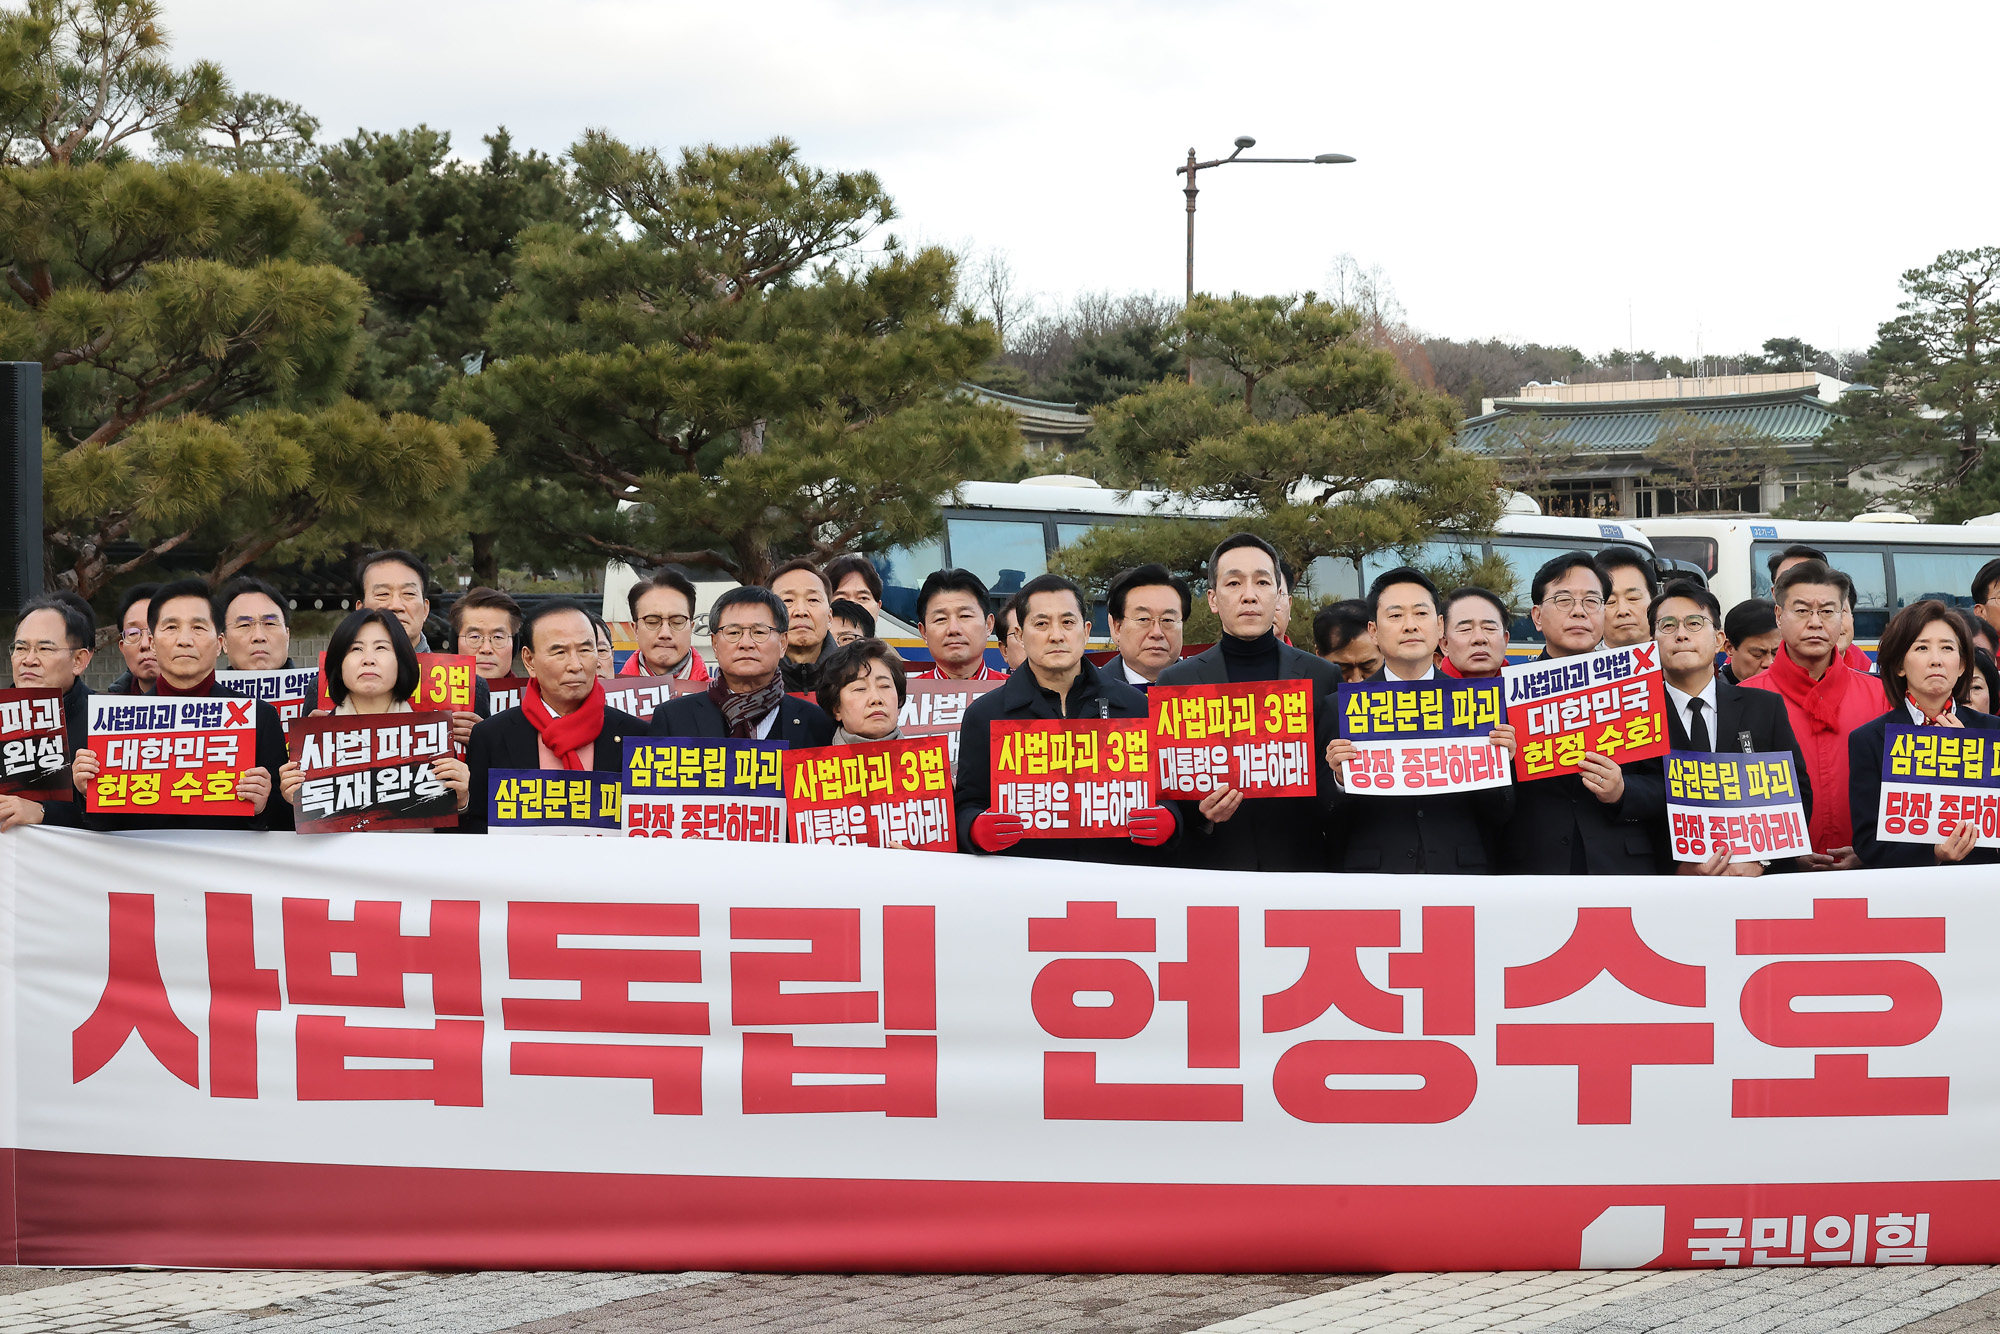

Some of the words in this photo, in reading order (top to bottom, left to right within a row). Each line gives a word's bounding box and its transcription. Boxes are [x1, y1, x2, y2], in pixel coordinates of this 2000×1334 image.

[430, 665, 470, 705] 3법
[1511, 661, 1590, 702] 사법파괴
[1593, 651, 1631, 681] 악법
[0, 698, 61, 734] 파괴
[93, 705, 176, 731] 사법파괴
[181, 702, 222, 728] 악법
[1157, 694, 1256, 739] 사법파괴
[1264, 691, 1307, 733] 3법
[1345, 689, 1444, 733] 삼권분립
[1452, 687, 1500, 729] 파괴
[1527, 680, 1649, 735] 대한민국
[3, 735, 64, 776] 완성
[106, 735, 239, 770] 대한민국
[301, 728, 371, 771] 사법
[376, 721, 447, 761] 파괴
[998, 730, 1098, 775] 사법파괴
[1107, 730, 1148, 772] 3법
[1158, 746, 1229, 792] 대통령은
[1233, 740, 1309, 788] 거부하라!
[1350, 749, 1395, 789] 당장
[1402, 744, 1504, 788] 중단하라!
[1523, 731, 1585, 775] 헌정
[1596, 713, 1662, 756] 수호!
[1890, 734, 1985, 779] 삼권분립
[97, 773, 163, 807] 헌정
[301, 771, 371, 815] 독재
[376, 763, 446, 804] 완성
[629, 746, 726, 787] 삼권분립
[734, 748, 782, 790] 파괴
[793, 752, 893, 802] 사법파괴
[900, 747, 945, 791] 3법
[1668, 759, 1741, 801] 삼권분립
[1745, 760, 1795, 799] 파괴
[495, 779, 591, 819] 삼권분립
[999, 782, 1069, 829] 대통령은
[1885, 792, 1932, 835] 당장
[628, 803, 674, 838] 당장
[681, 803, 780, 842] 중단하라!
[795, 805, 868, 847] 대통령은
[870, 798, 949, 848] 거부하라!
[1673, 813, 1706, 855] 당장
[1709, 812, 1804, 857] 중단하라!
[73, 892, 937, 1118] 사법독립
[1028, 898, 1949, 1125] 헌정수호
[1688, 1213, 1930, 1265] 국민의힘
